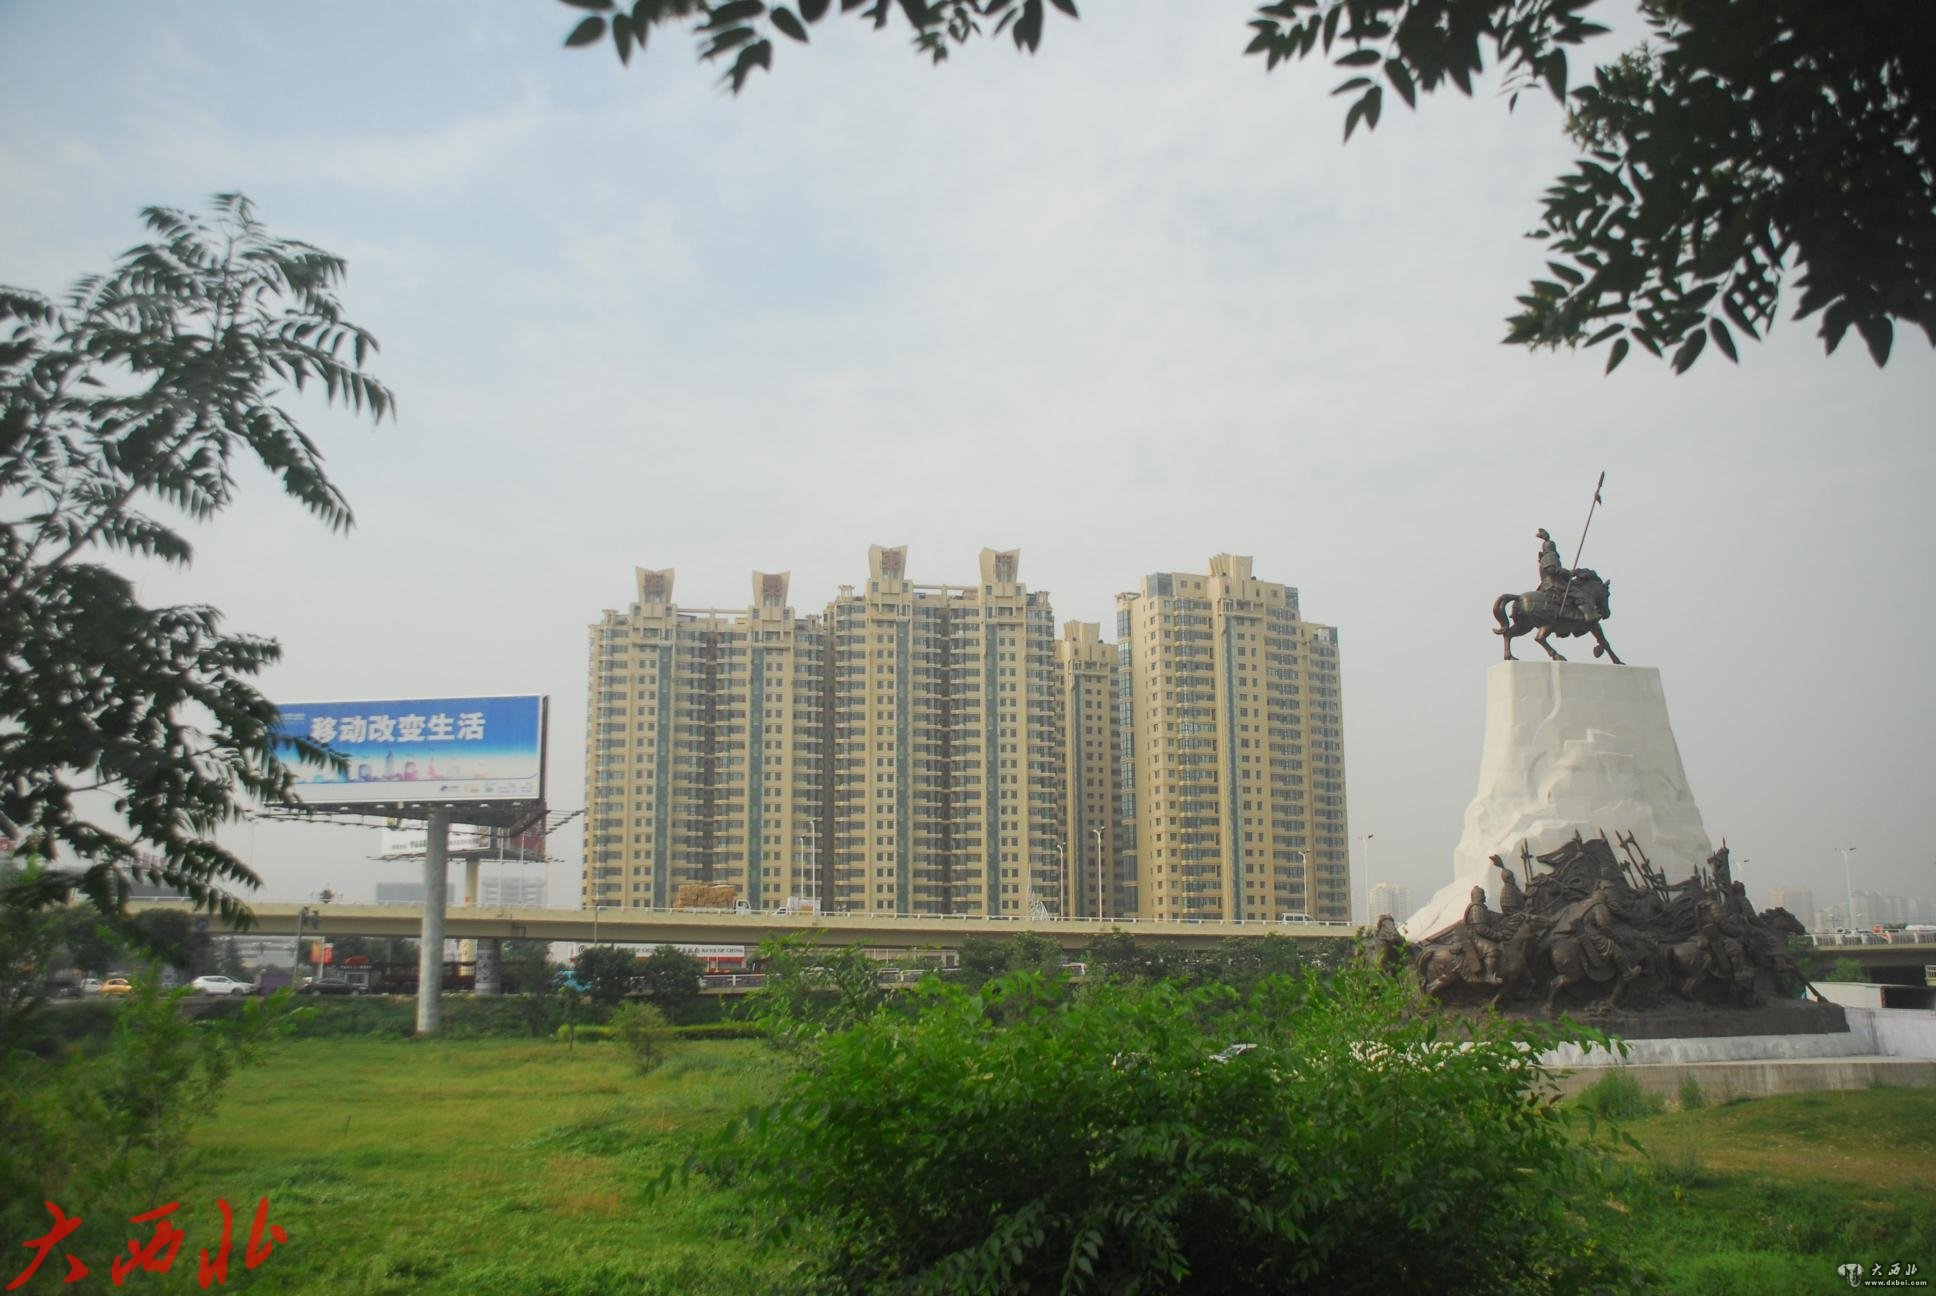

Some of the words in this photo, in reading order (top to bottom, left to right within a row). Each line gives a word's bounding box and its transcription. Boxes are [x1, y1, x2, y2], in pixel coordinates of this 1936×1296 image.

[309, 711, 486, 744] 移动改变生活
